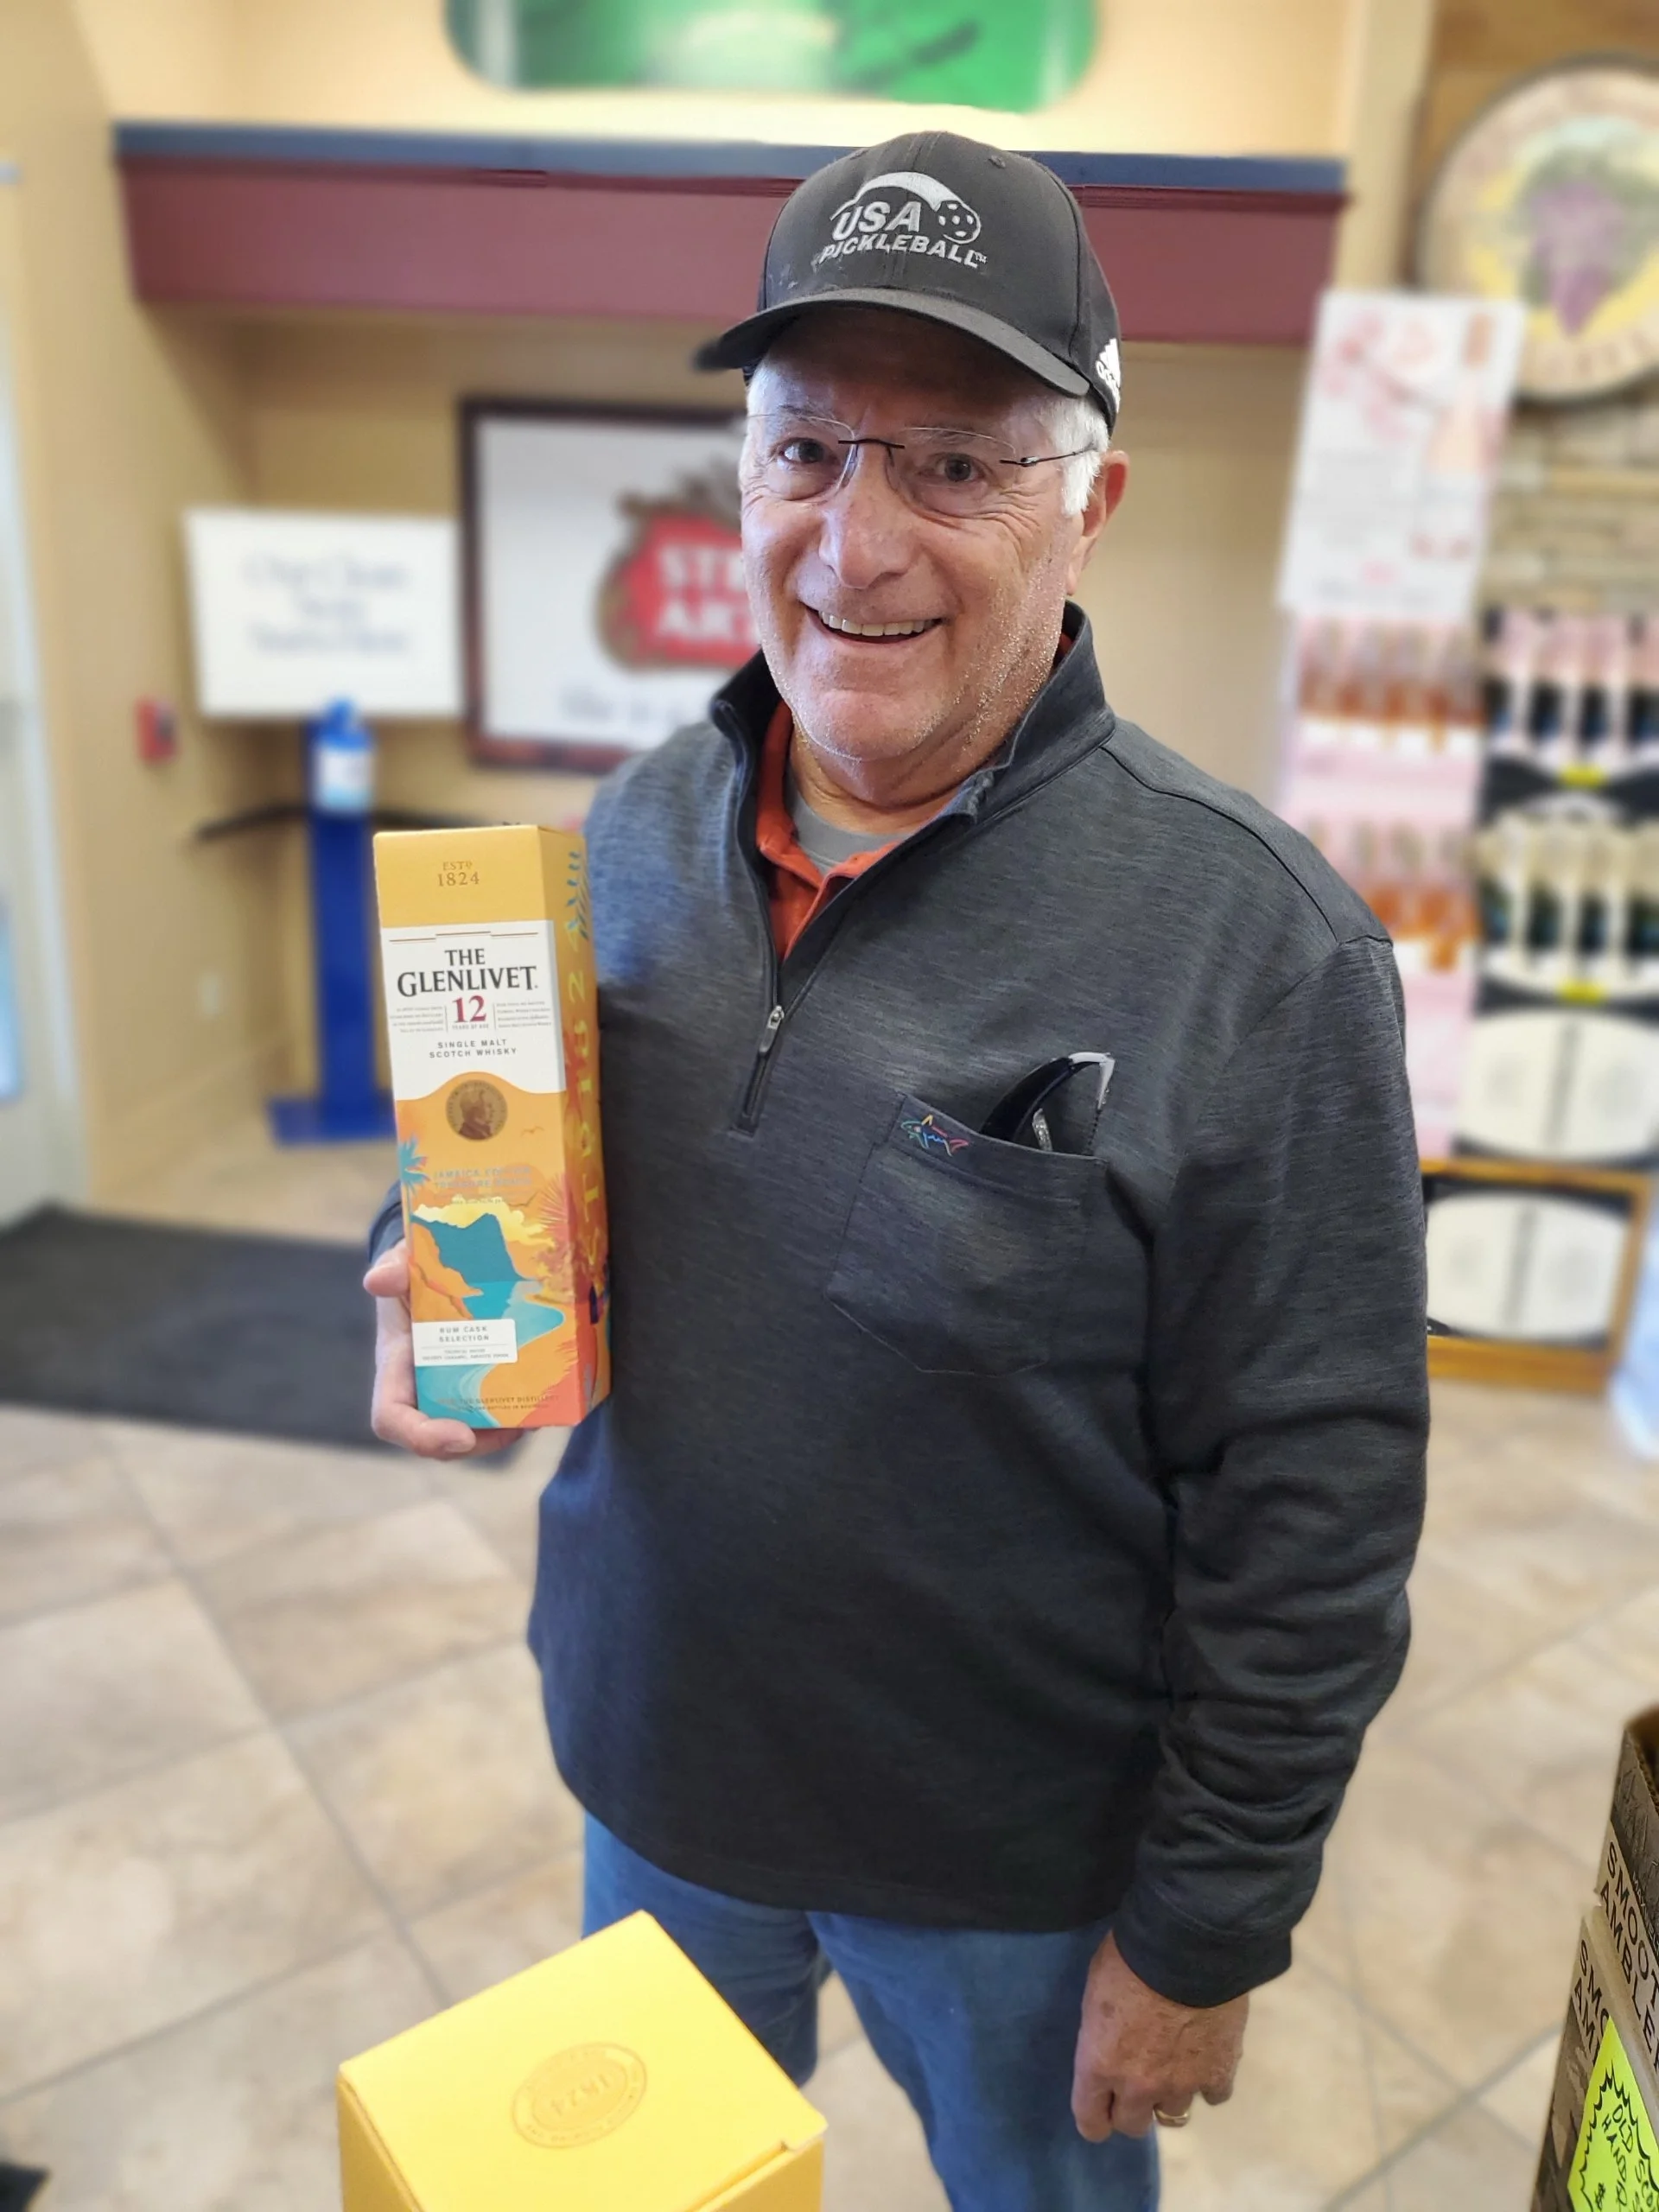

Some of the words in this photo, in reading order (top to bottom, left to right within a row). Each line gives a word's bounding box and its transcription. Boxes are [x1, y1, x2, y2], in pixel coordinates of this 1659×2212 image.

[831, 200, 922, 241] USA
[437, 871, 480, 887] 1824
[444, 948, 486, 966] THE
[452, 995, 487, 1024] 12
[429, 1050, 471, 1058] SCOTCH
[476, 1047, 517, 1057] WHISKY
[437, 1040, 476, 1049] SINGLE
[1612, 2104, 1633, 2153] OLD
